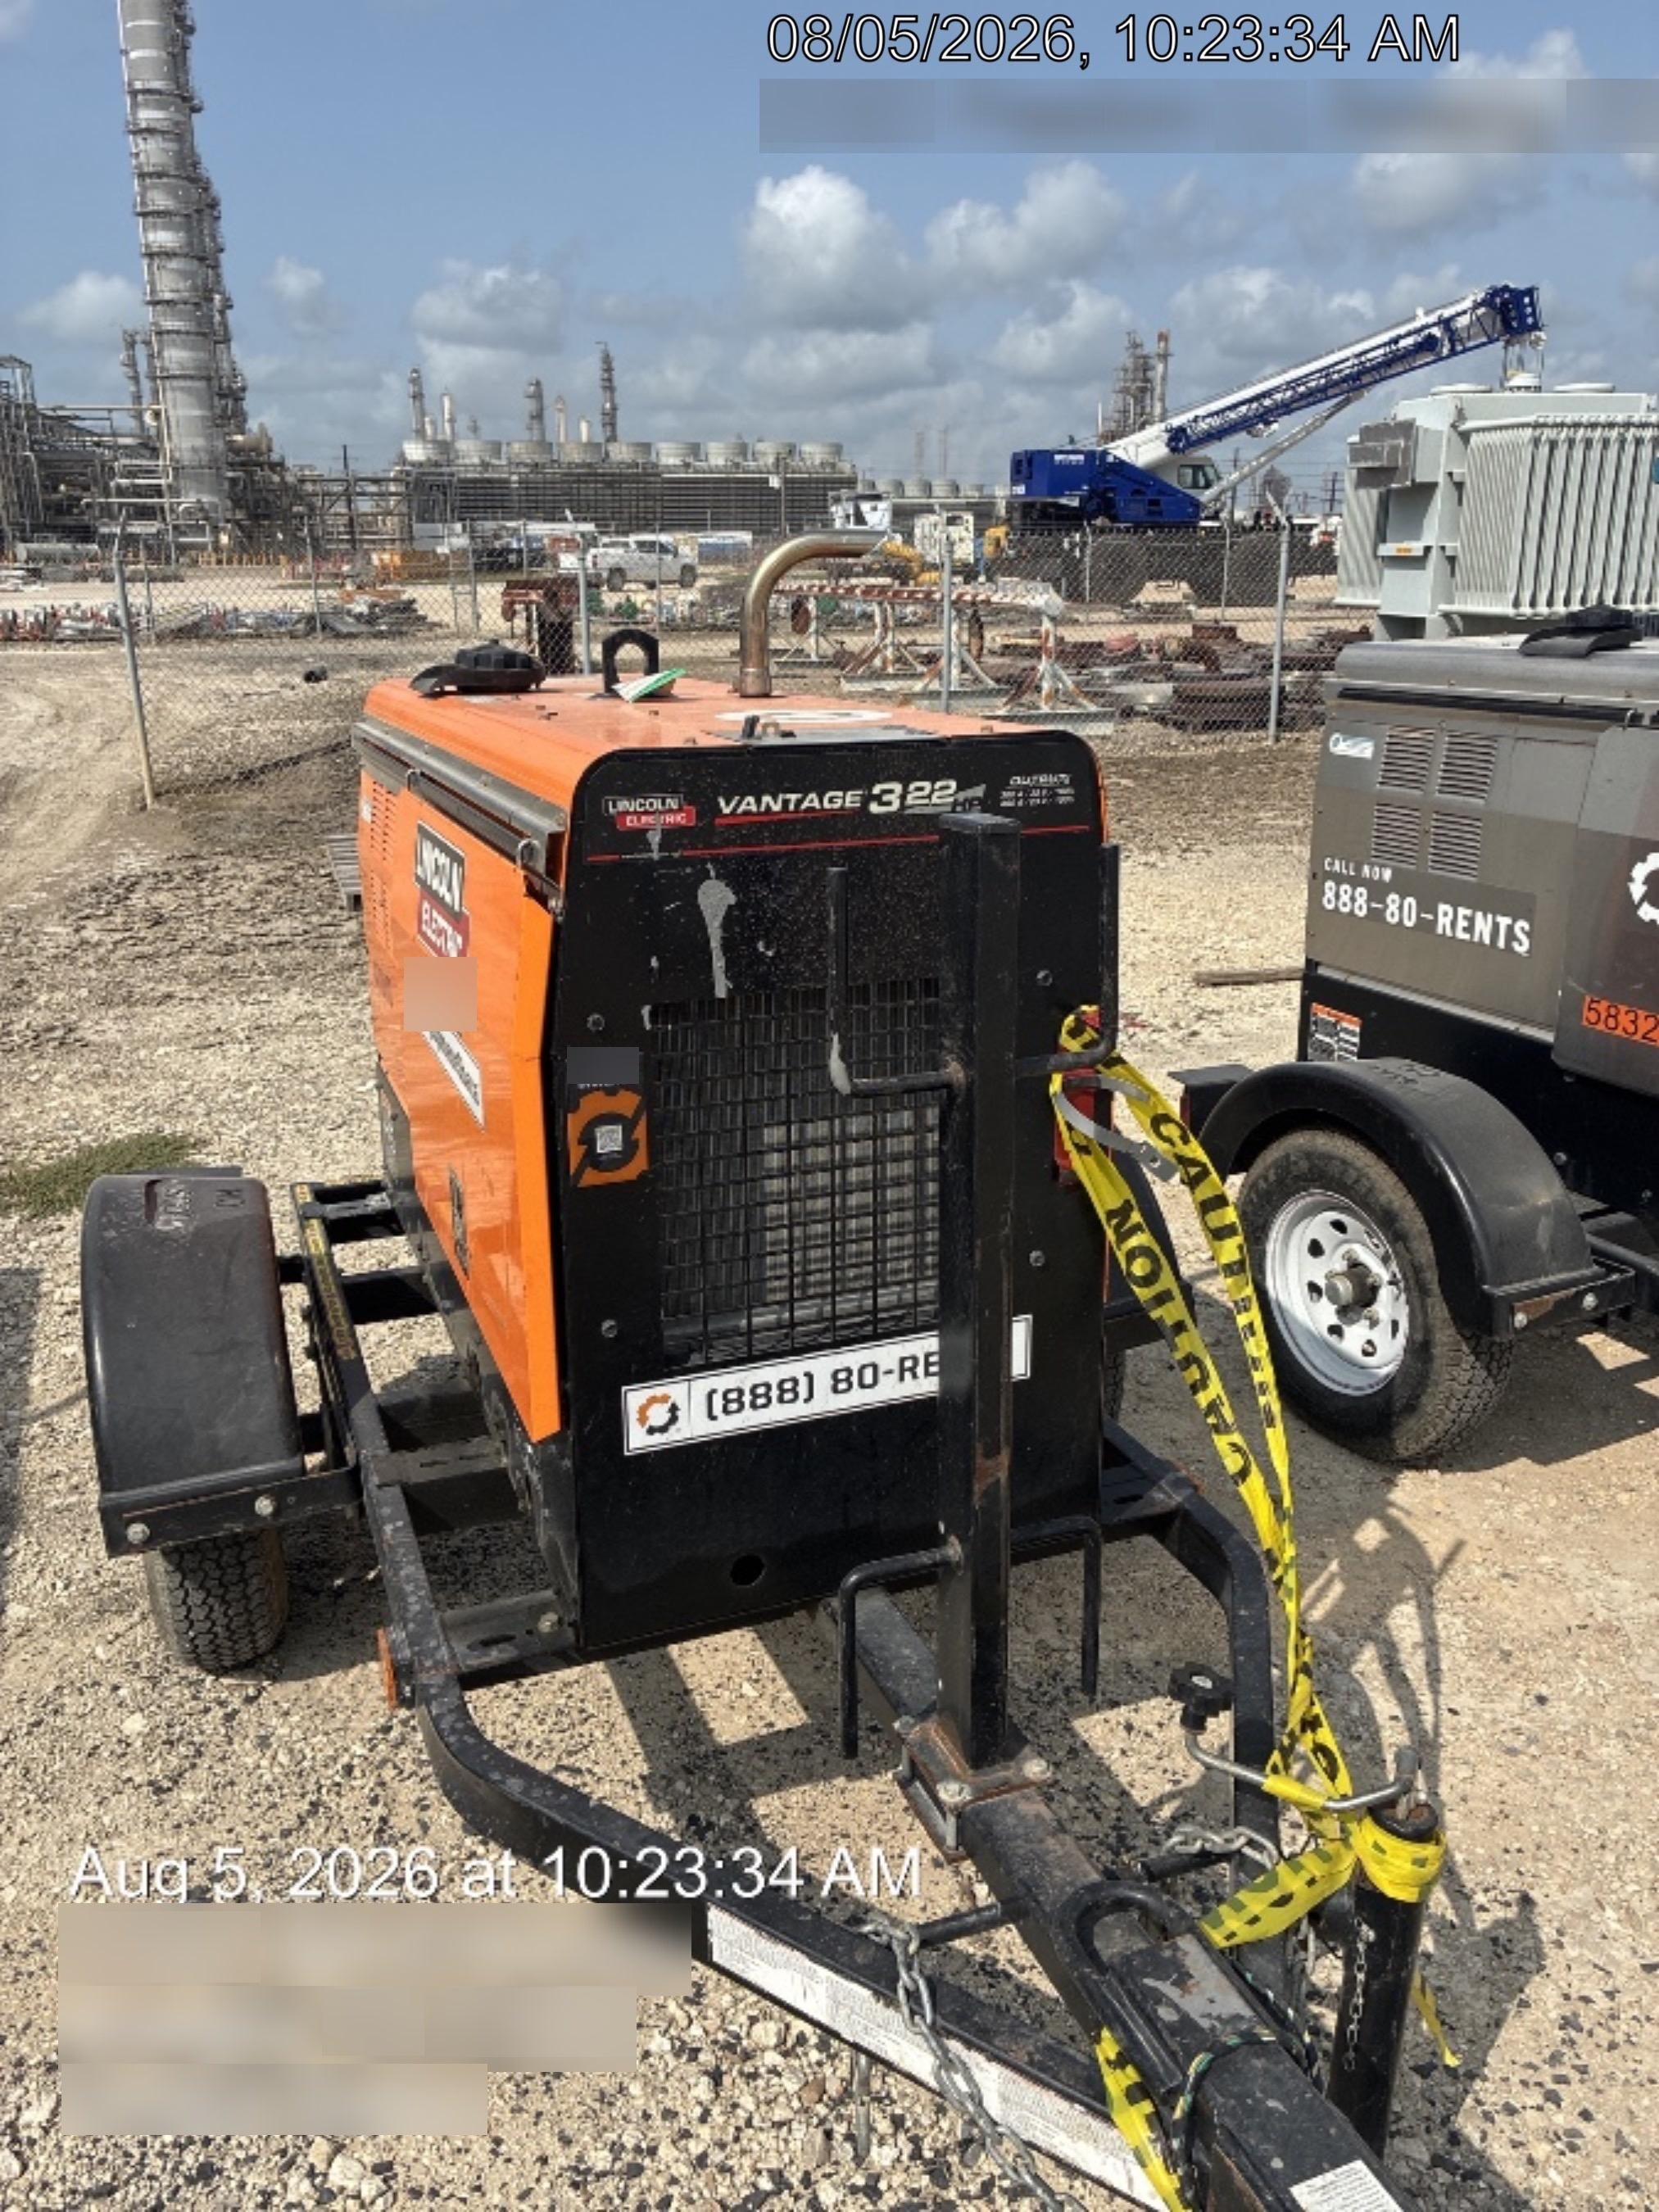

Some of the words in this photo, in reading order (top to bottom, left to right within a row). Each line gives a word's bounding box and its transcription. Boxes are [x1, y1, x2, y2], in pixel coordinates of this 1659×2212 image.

[608, 797, 680, 814] LINCOLN
[718, 789, 864, 815] VANTAGE
[869, 779, 956, 814] 322
[416, 832, 464, 913] LINCOLN
[1324, 857, 1356, 876] CALL
[1361, 863, 1393, 883] NOW
[1321, 879, 1531, 957] 888-80-RENTS
[1585, 997, 1659, 1043] 5832
[705, 1371, 816, 1421] (888)
[830, 1351, 939, 1395] 80-RE
